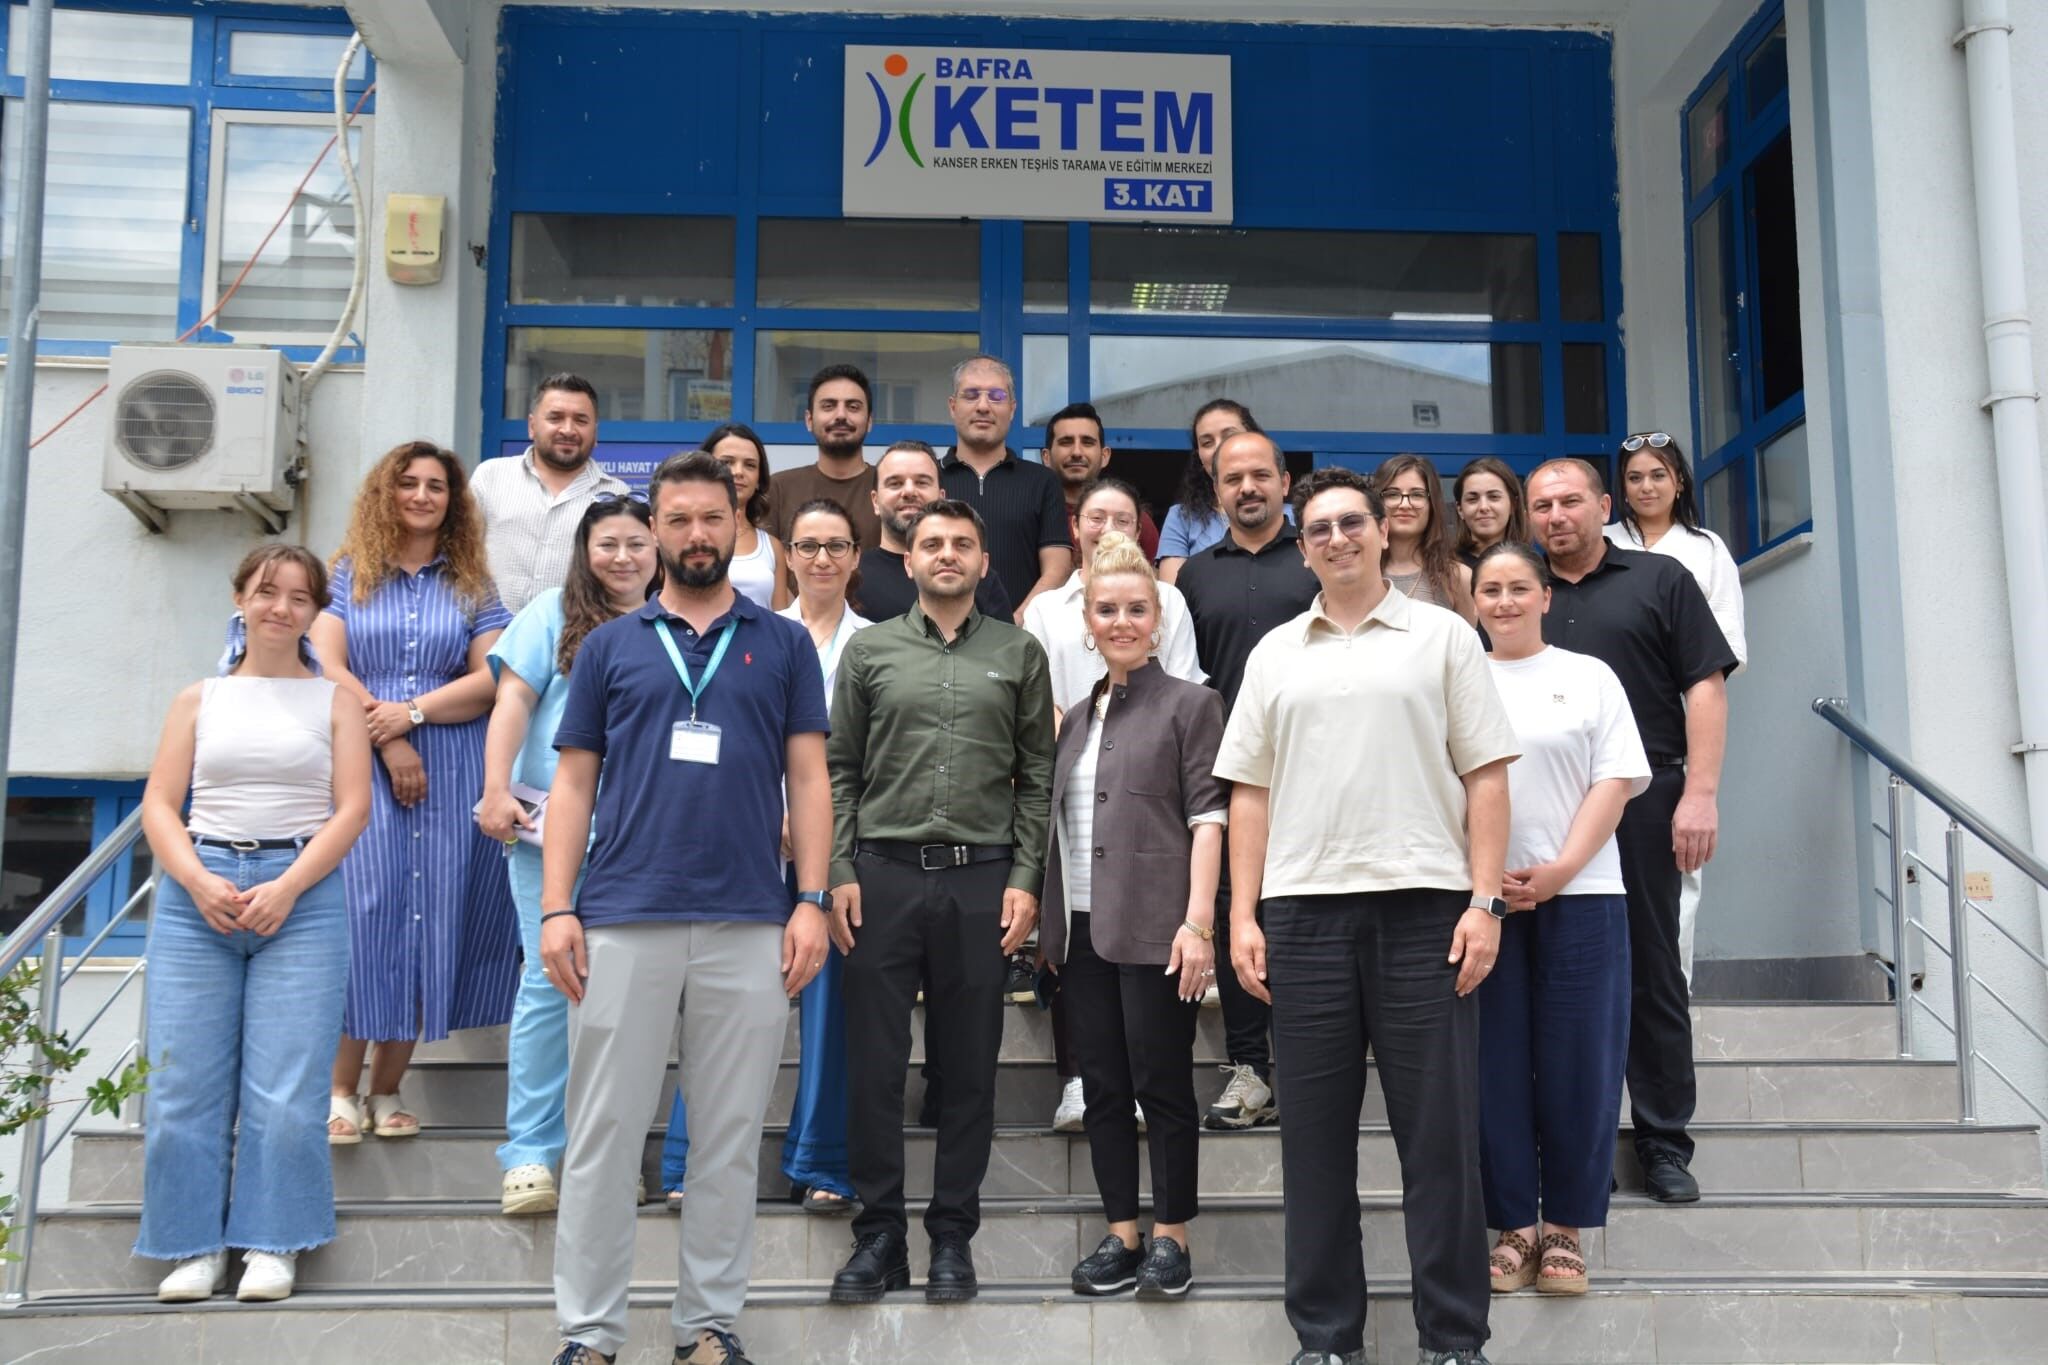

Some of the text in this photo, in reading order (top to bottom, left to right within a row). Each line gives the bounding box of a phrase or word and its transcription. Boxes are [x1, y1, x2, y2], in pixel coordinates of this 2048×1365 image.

[935, 57, 1033, 80] BAFRA
[934, 86, 1213, 154] KETEM
[933, 156, 1213, 175] KANSER ERKEN TEŞHİS TARAMA VE EĞİTİM MERKEZİ
[1112, 183, 1205, 208] 3. KAT
[618, 461, 651, 473] HAYAT
